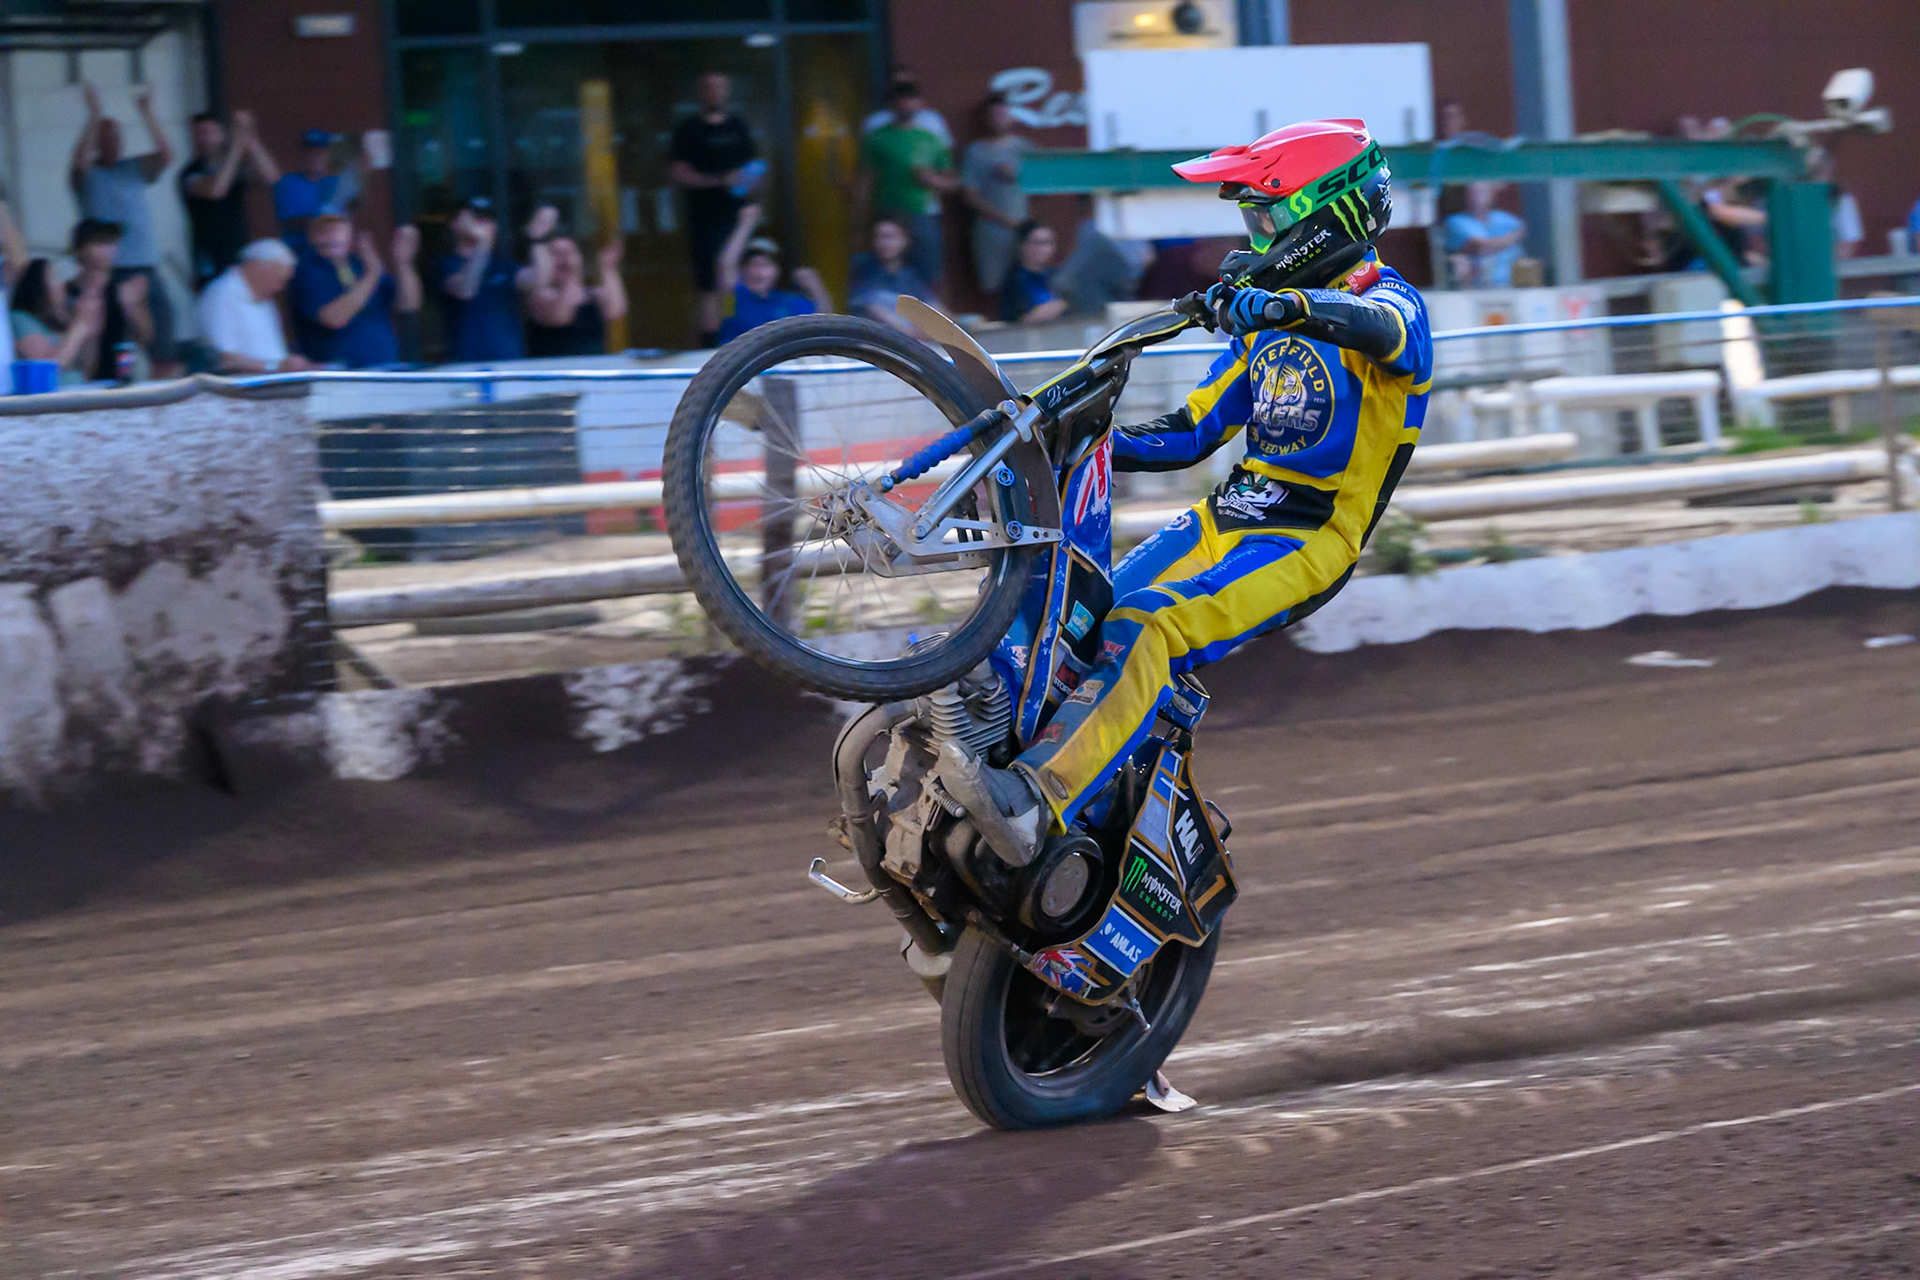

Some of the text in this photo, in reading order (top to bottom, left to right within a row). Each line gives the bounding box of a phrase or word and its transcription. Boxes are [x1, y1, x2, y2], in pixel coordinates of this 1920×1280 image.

[1275, 228, 1332, 271] MONSTER
[1253, 345, 1326, 392] SHEFFIELD
[1141, 872, 1183, 915] MONSTER
[1193, 874, 1227, 912] 1
[1110, 933, 1143, 963] ANLAS
